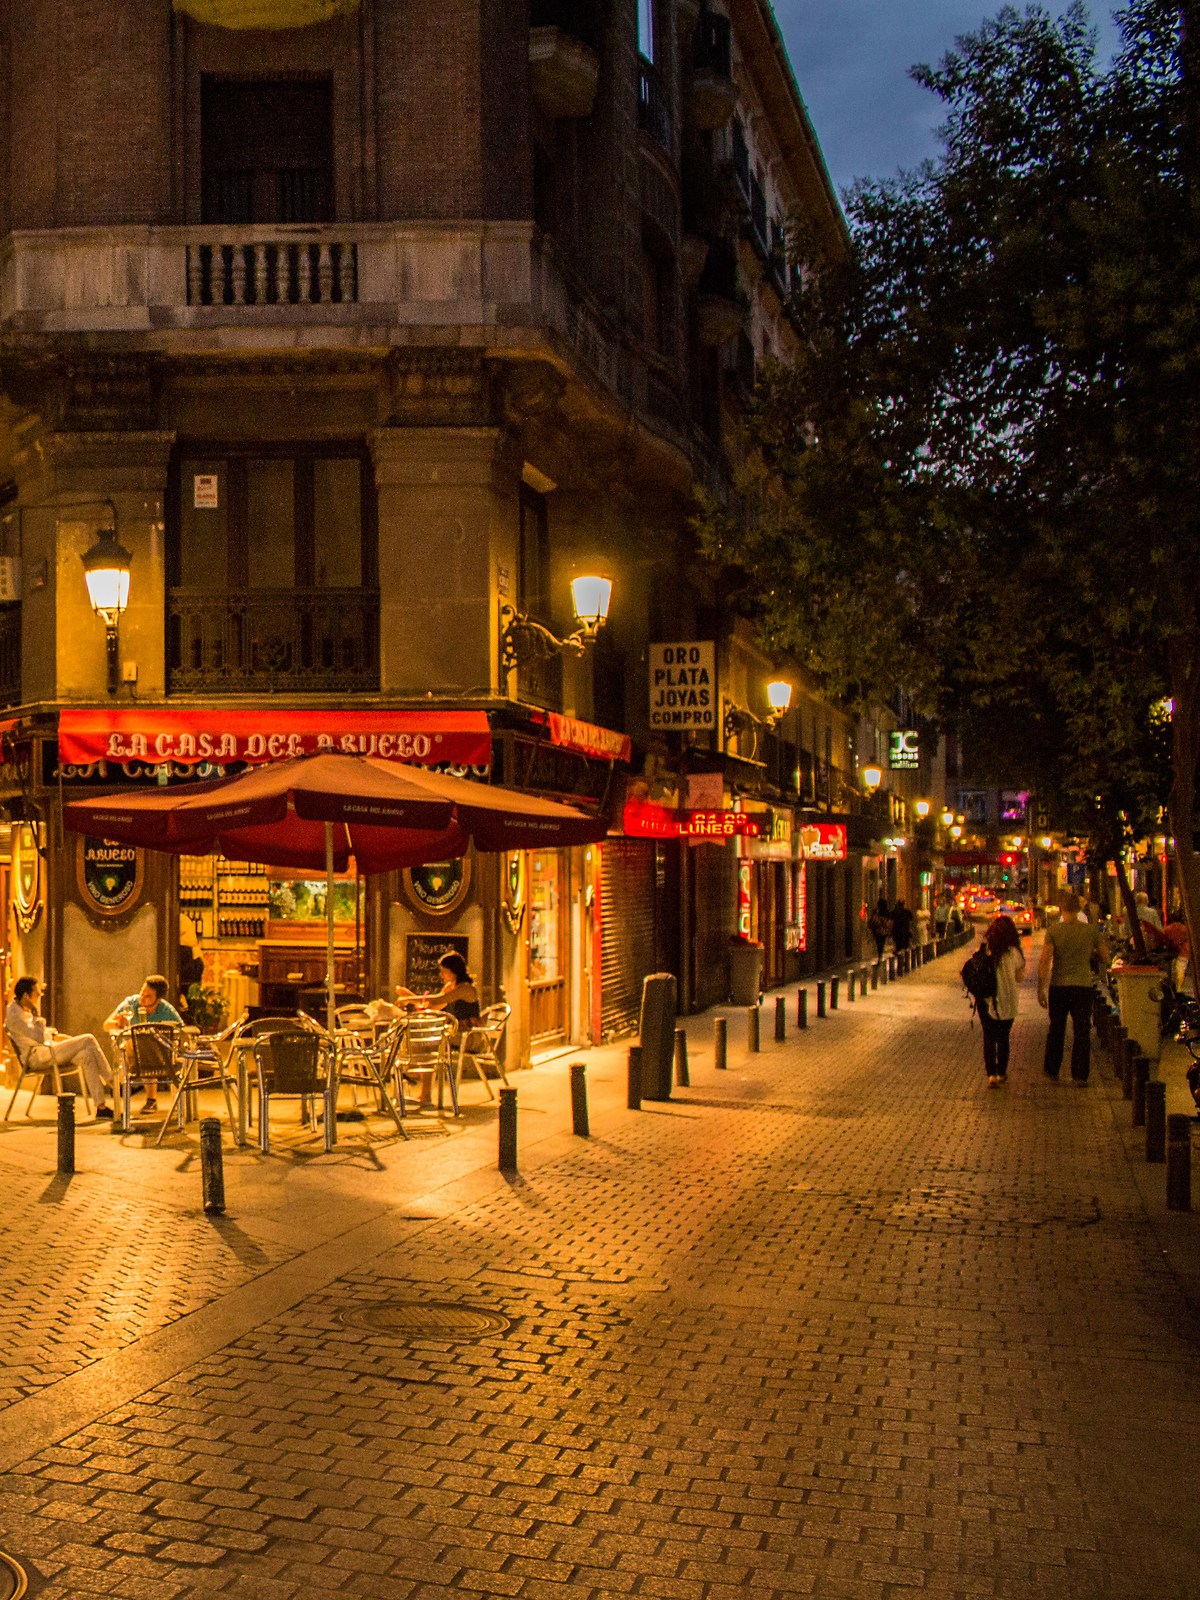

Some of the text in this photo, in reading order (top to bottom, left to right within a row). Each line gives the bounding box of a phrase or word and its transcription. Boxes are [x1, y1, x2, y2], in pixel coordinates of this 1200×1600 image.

[664, 647, 700, 664] ORO
[654, 668, 709, 686] PLATA
[656, 689, 709, 706] JOYAS
[652, 710, 712, 724] COMPRO
[106, 733, 147, 757] LA
[154, 733, 237, 757] CASA
[244, 733, 305, 757] DEL
[680, 823, 734, 835] LUNES
[85, 848, 135, 861] ABUELO
